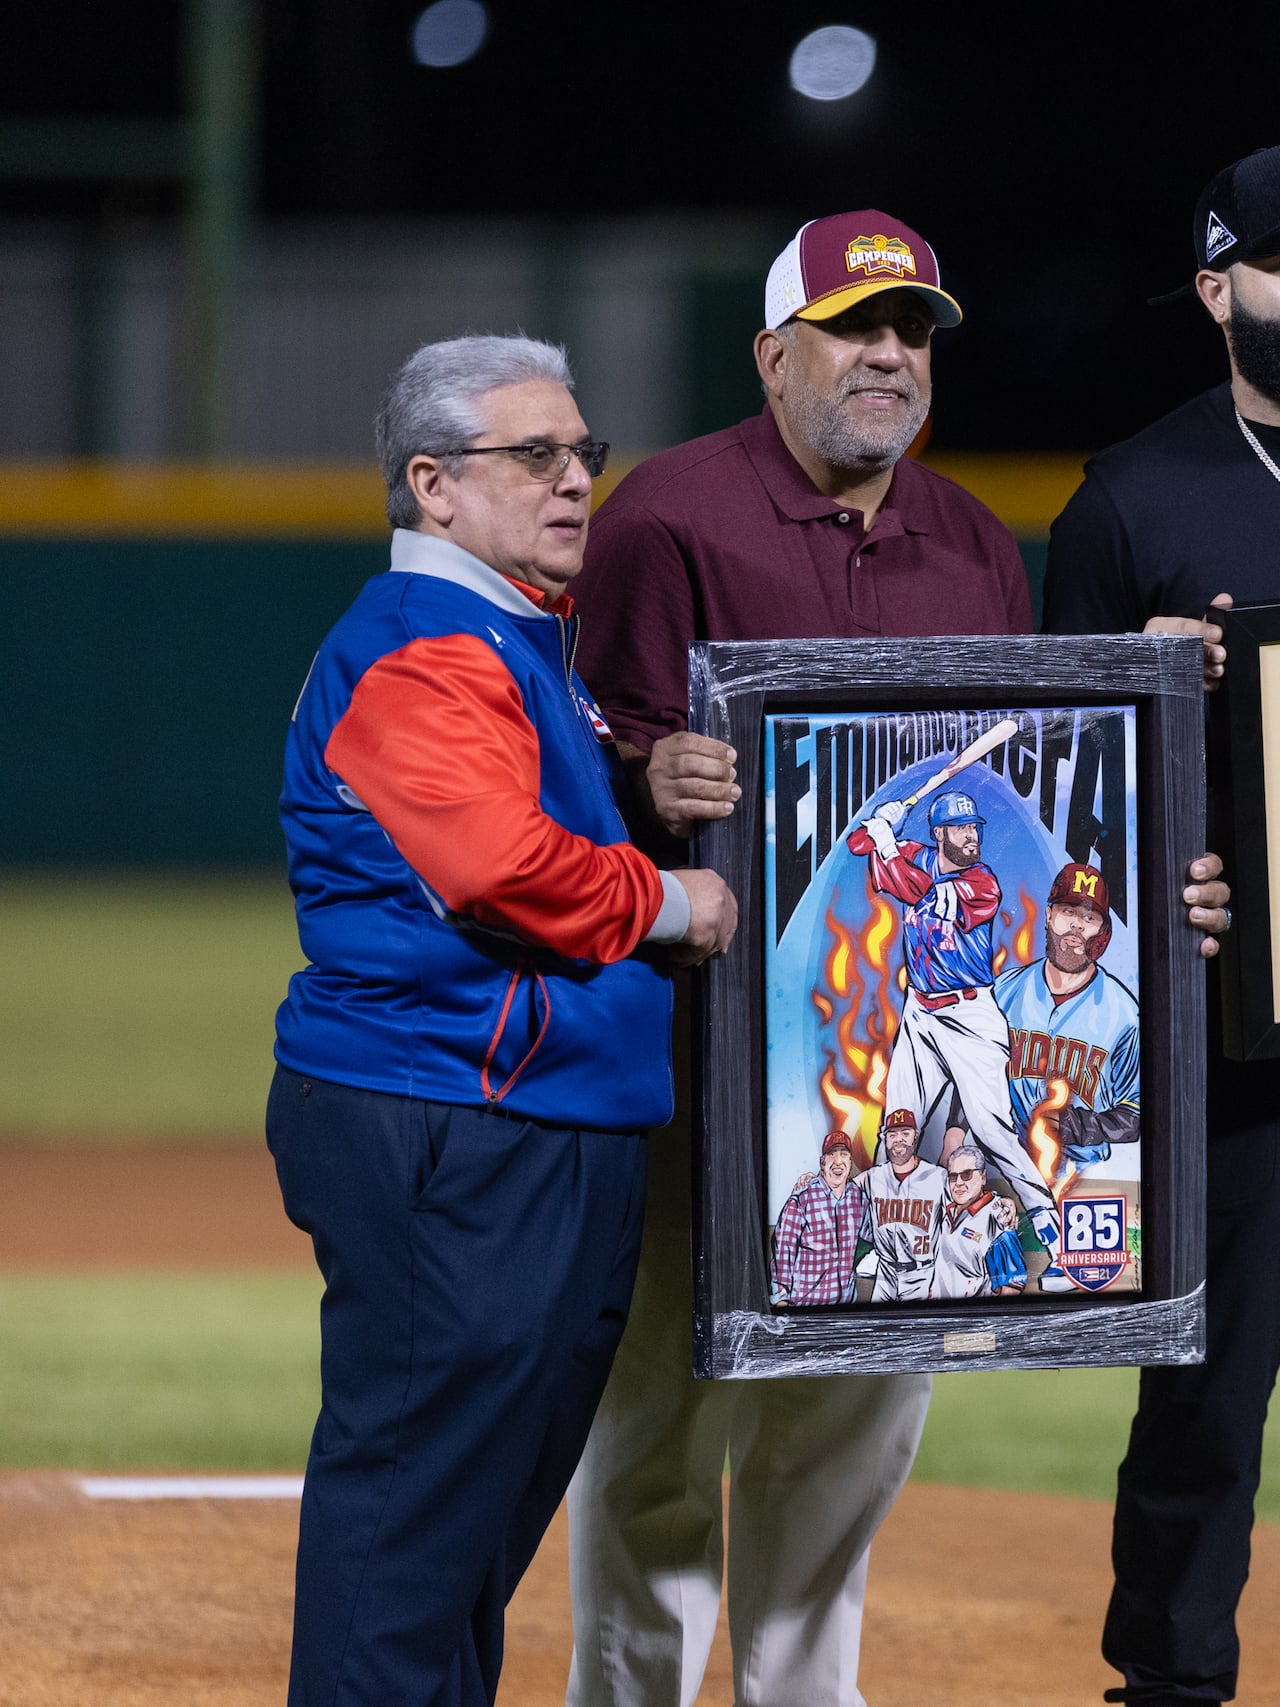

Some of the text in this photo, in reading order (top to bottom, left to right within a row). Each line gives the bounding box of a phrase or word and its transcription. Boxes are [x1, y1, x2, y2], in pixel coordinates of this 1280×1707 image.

[1073, 871, 1099, 898] M
[1009, 1027, 1109, 1110] NDIOS
[894, 1111, 905, 1124] M
[1068, 1204, 1120, 1251] 85
[913, 1235, 930, 1255] 26
[1061, 1252, 1127, 1266] ANIVERSARIO
[1100, 1268, 1110, 1280] 21
